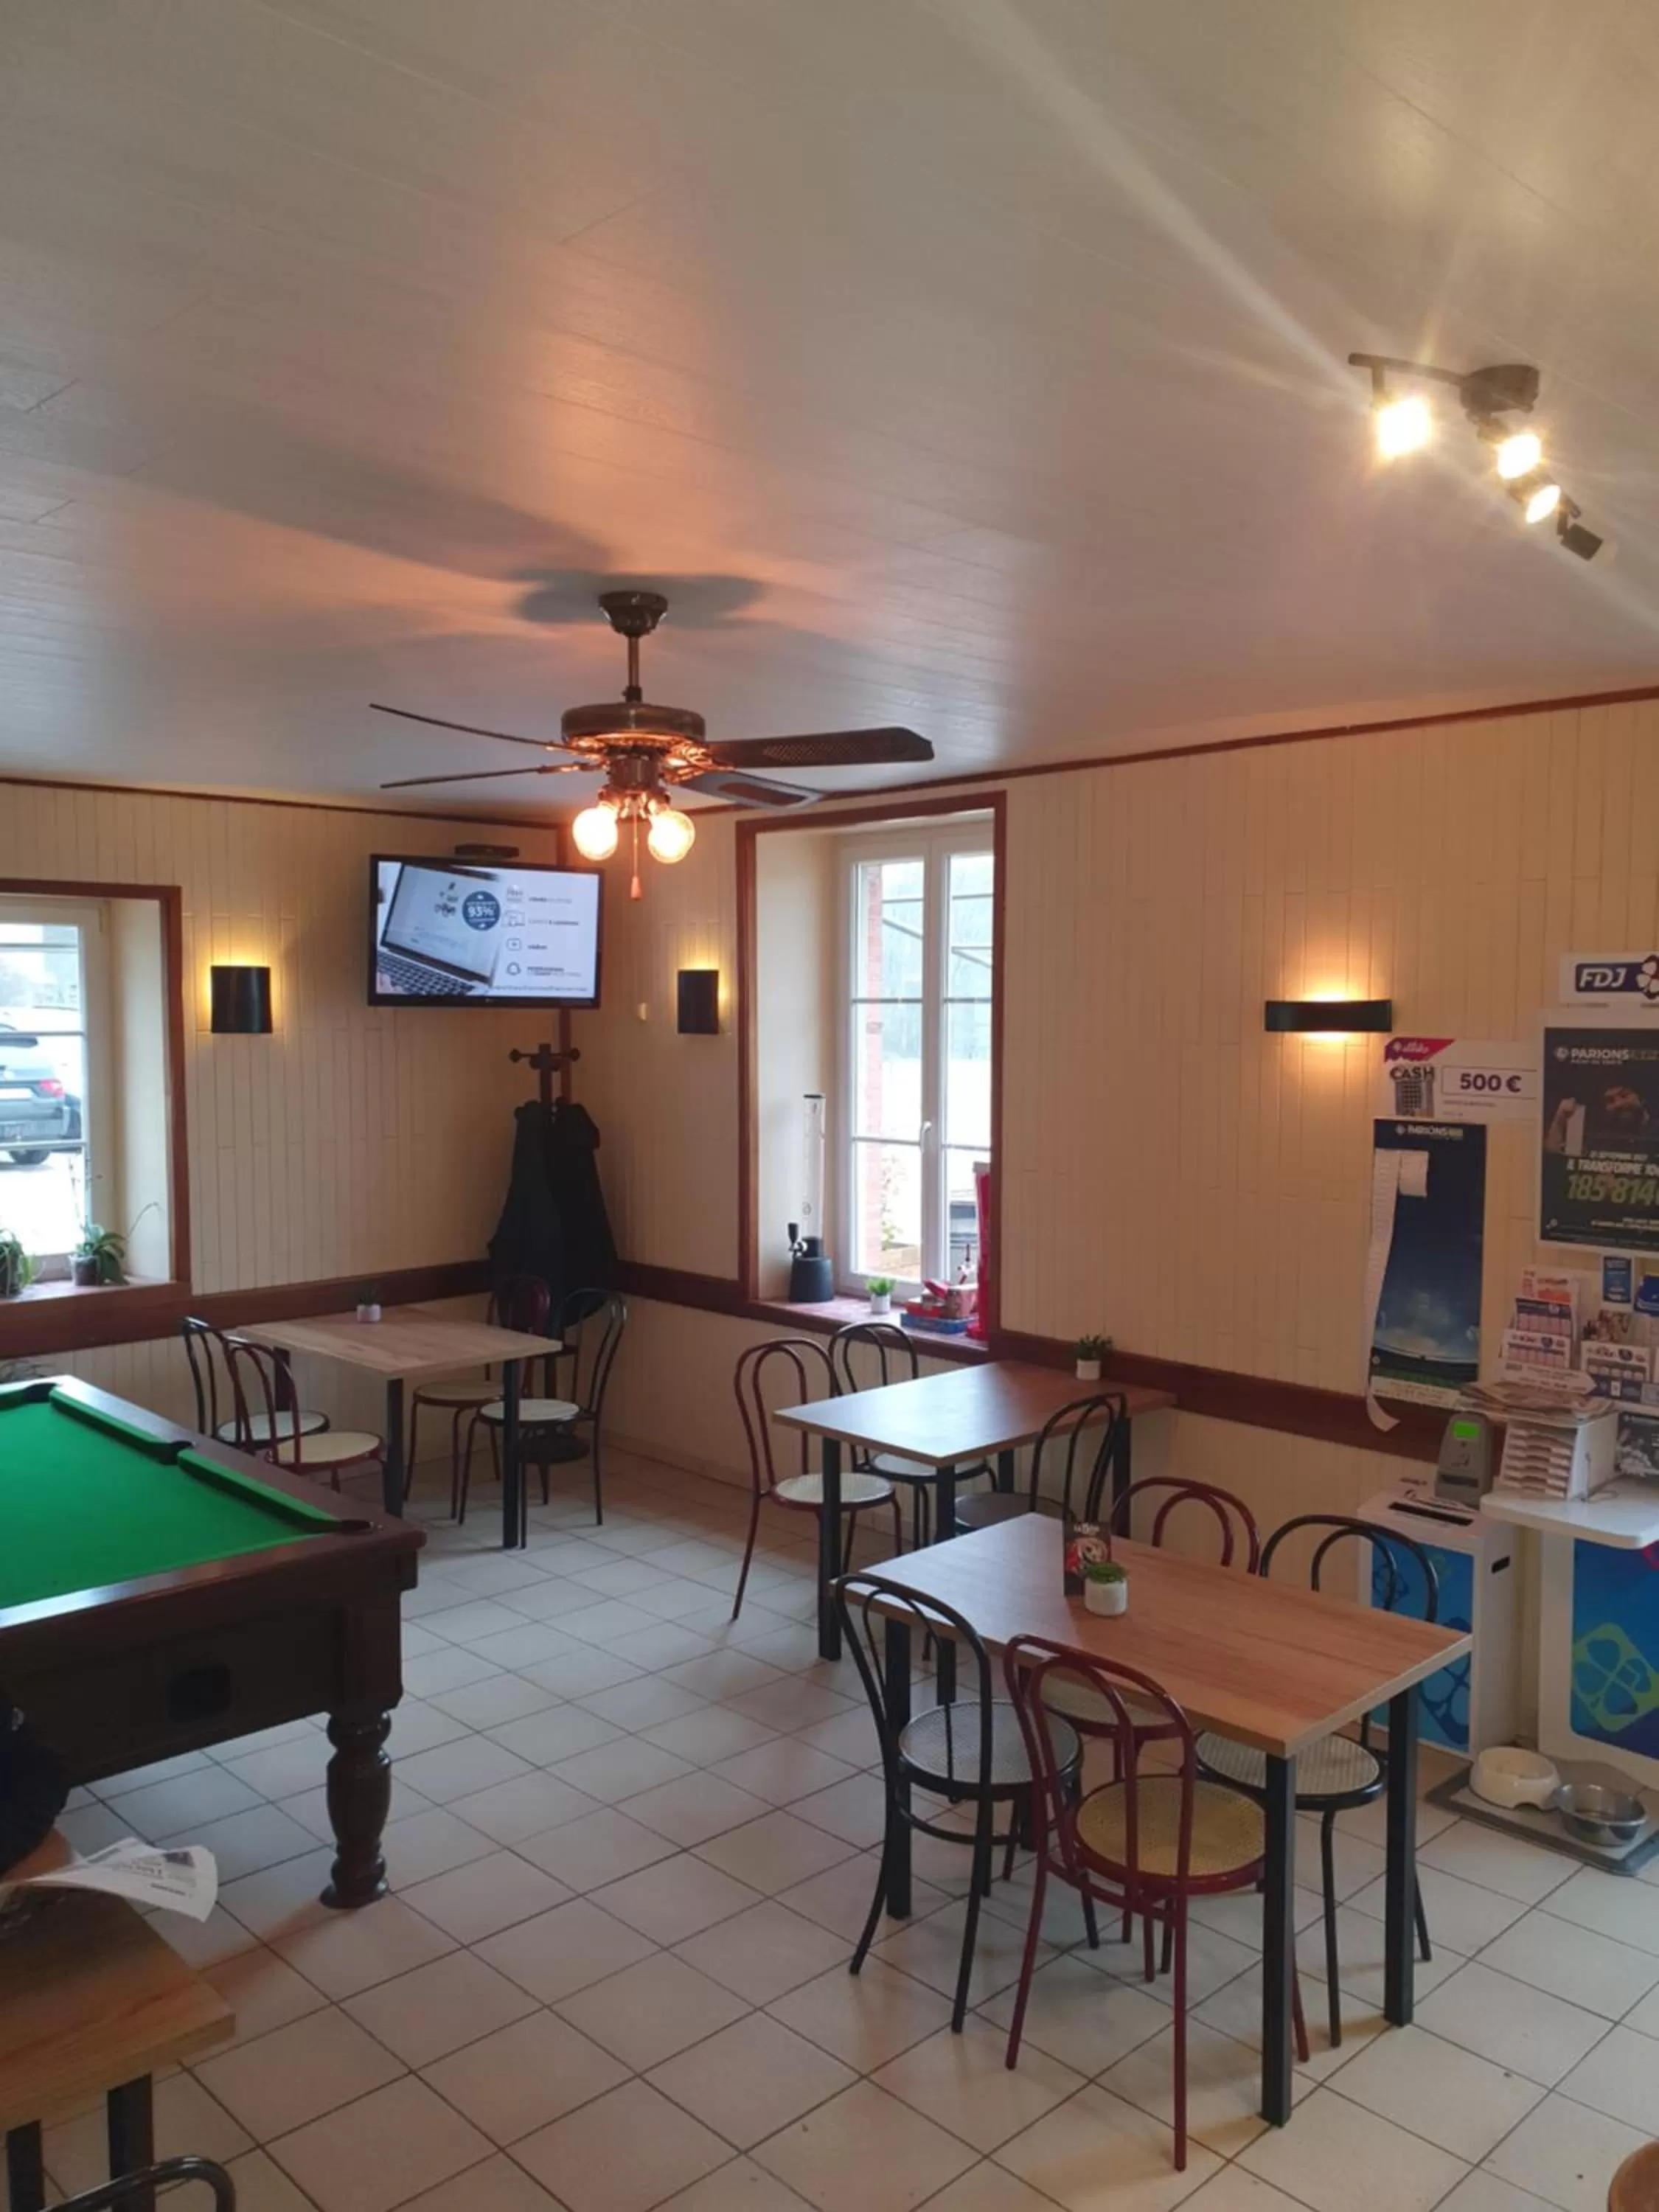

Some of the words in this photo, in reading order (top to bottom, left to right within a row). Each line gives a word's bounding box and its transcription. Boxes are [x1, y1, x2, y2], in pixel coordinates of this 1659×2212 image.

[1579, 967, 1627, 989] FDJ
[1390, 1067, 1435, 1081] CASH
[1460, 1073, 1501, 1092] 500
[1506, 1076, 1522, 1093] €
[1567, 1174, 1606, 1201] 185
